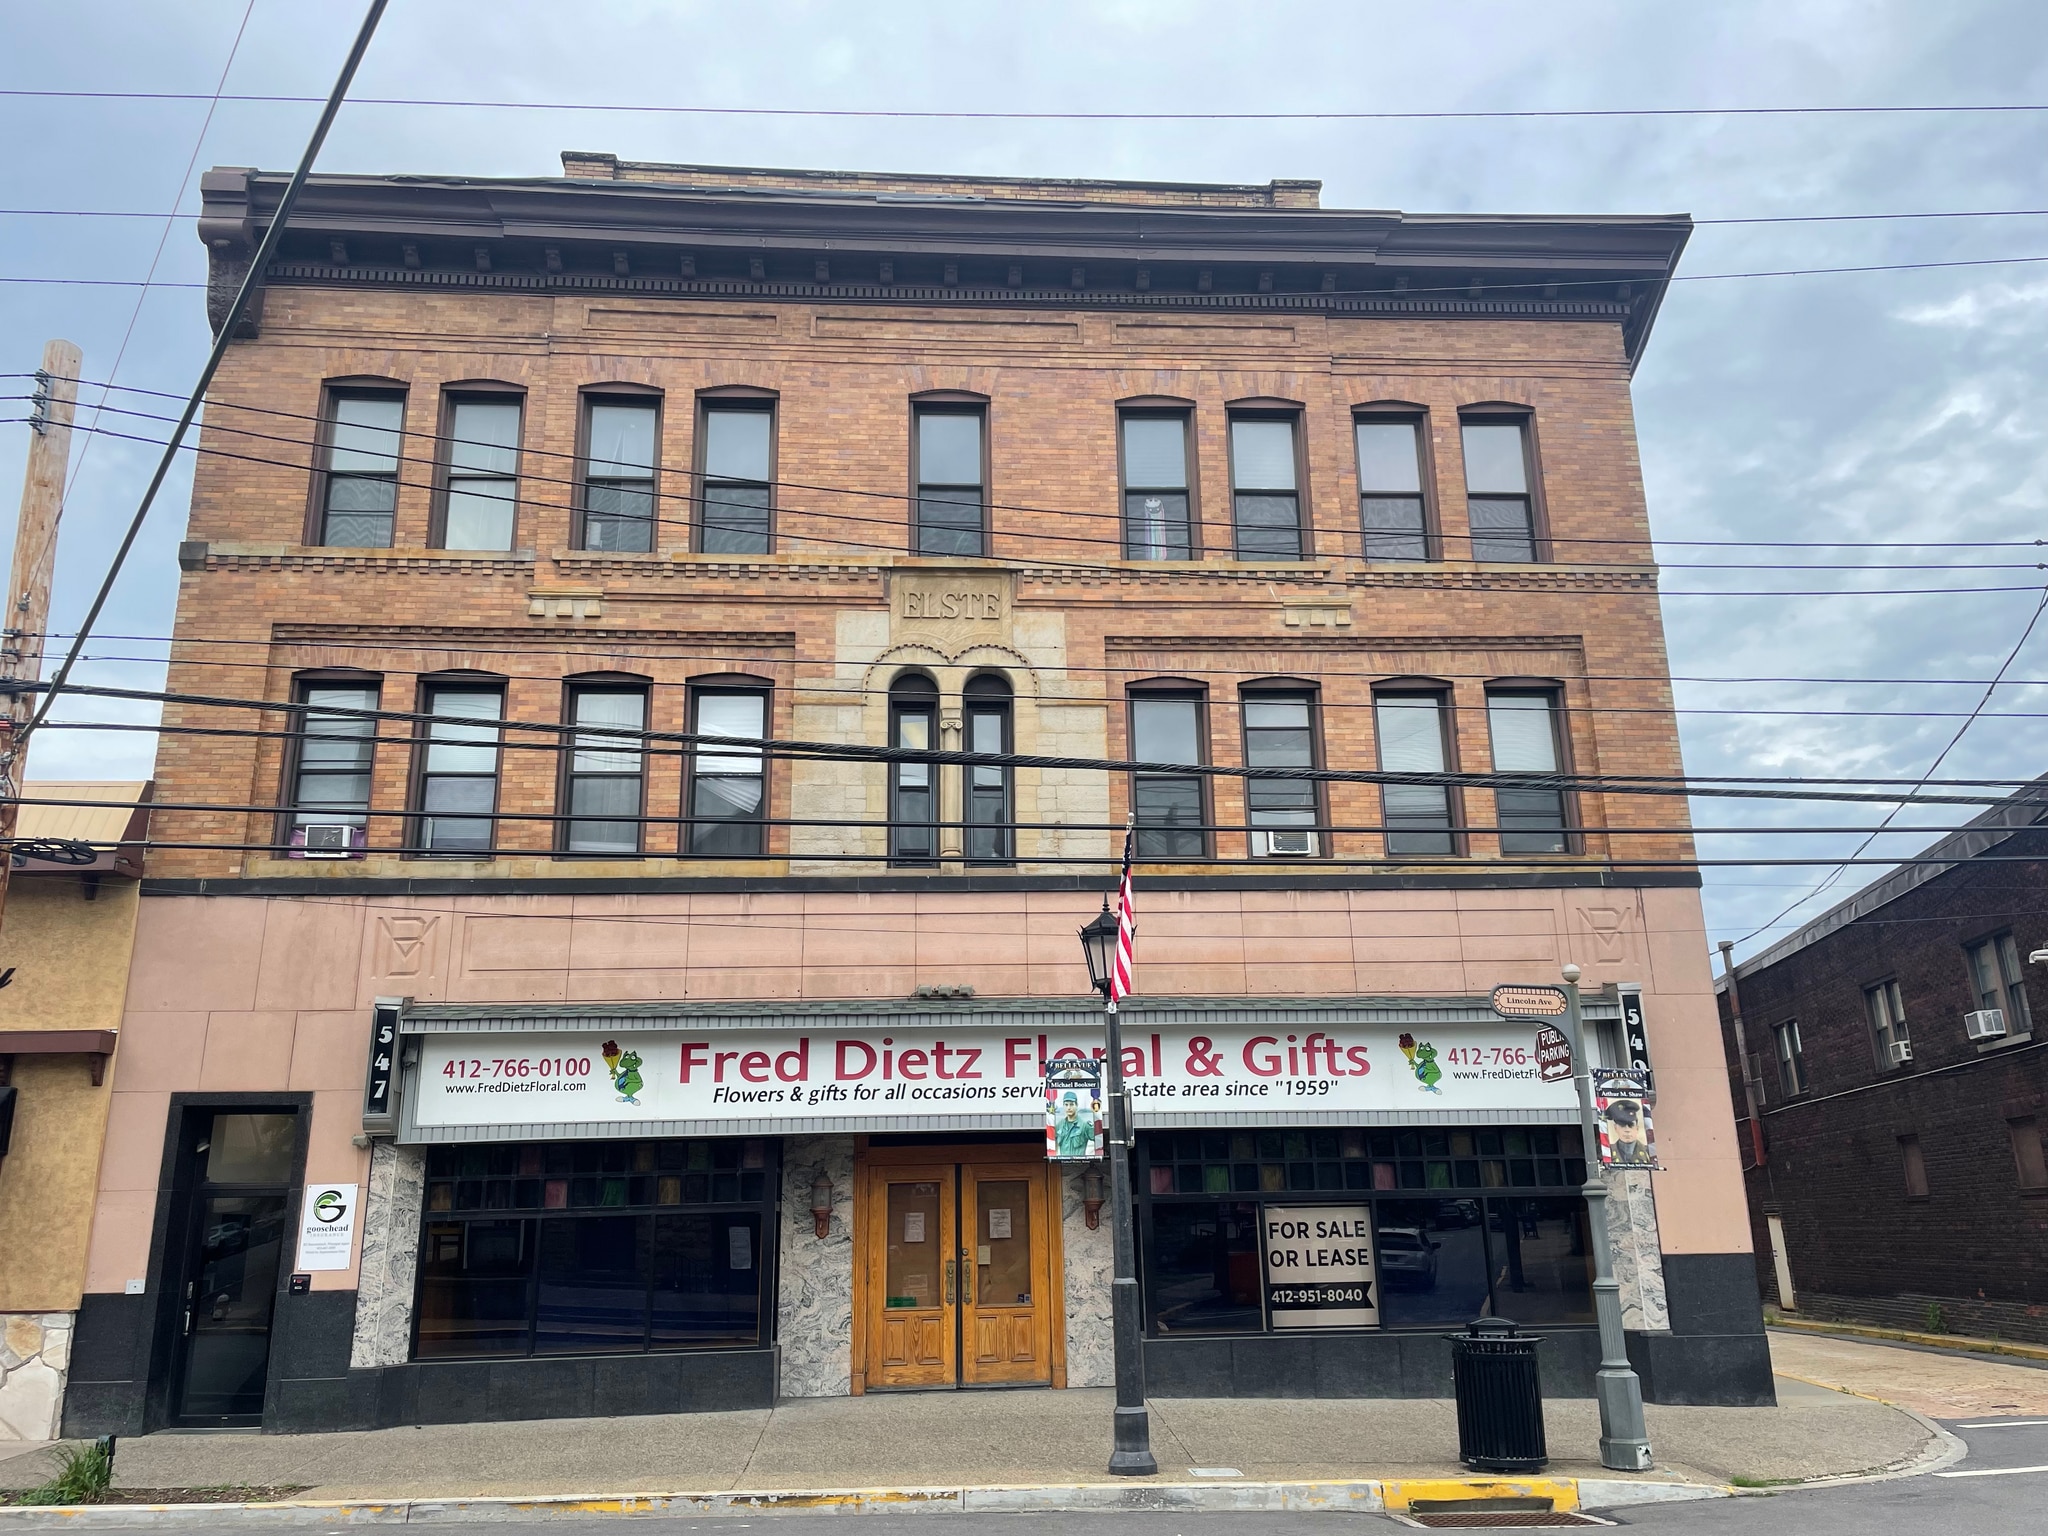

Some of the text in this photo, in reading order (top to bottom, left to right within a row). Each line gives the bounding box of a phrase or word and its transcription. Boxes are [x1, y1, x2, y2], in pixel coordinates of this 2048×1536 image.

[903, 592, 1000, 620] ELSTE
[1506, 997, 1553, 1006] Lincoln Ave
[1540, 1029, 1565, 1047] PUBLI
[373, 1025, 393, 1099] 547
[679, 1037, 810, 1084] Fred
[835, 1037, 983, 1082] Dietz
[1185, 1035, 1225, 1078] &
[1242, 1032, 1372, 1078] Gifts
[1447, 1047, 1541, 1066] 412-766-
[1540, 1043, 1569, 1063] PARKING
[442, 1057, 591, 1079] 412-766-0100
[1452, 1069, 1542, 1080] www.FredDietzFl
[445, 1080, 587, 1094] www.FredDietzFloral.com
[713, 1080, 1339, 1106] Flowers & gifts for all occasions servi i-state area since "1959"
[306, 1224, 349, 1234] goosehead
[1268, 1220, 1367, 1240] FOR SALE
[1269, 1248, 1370, 1268] OR LEASE
[1271, 1288, 1363, 1303] 412-951-8040
